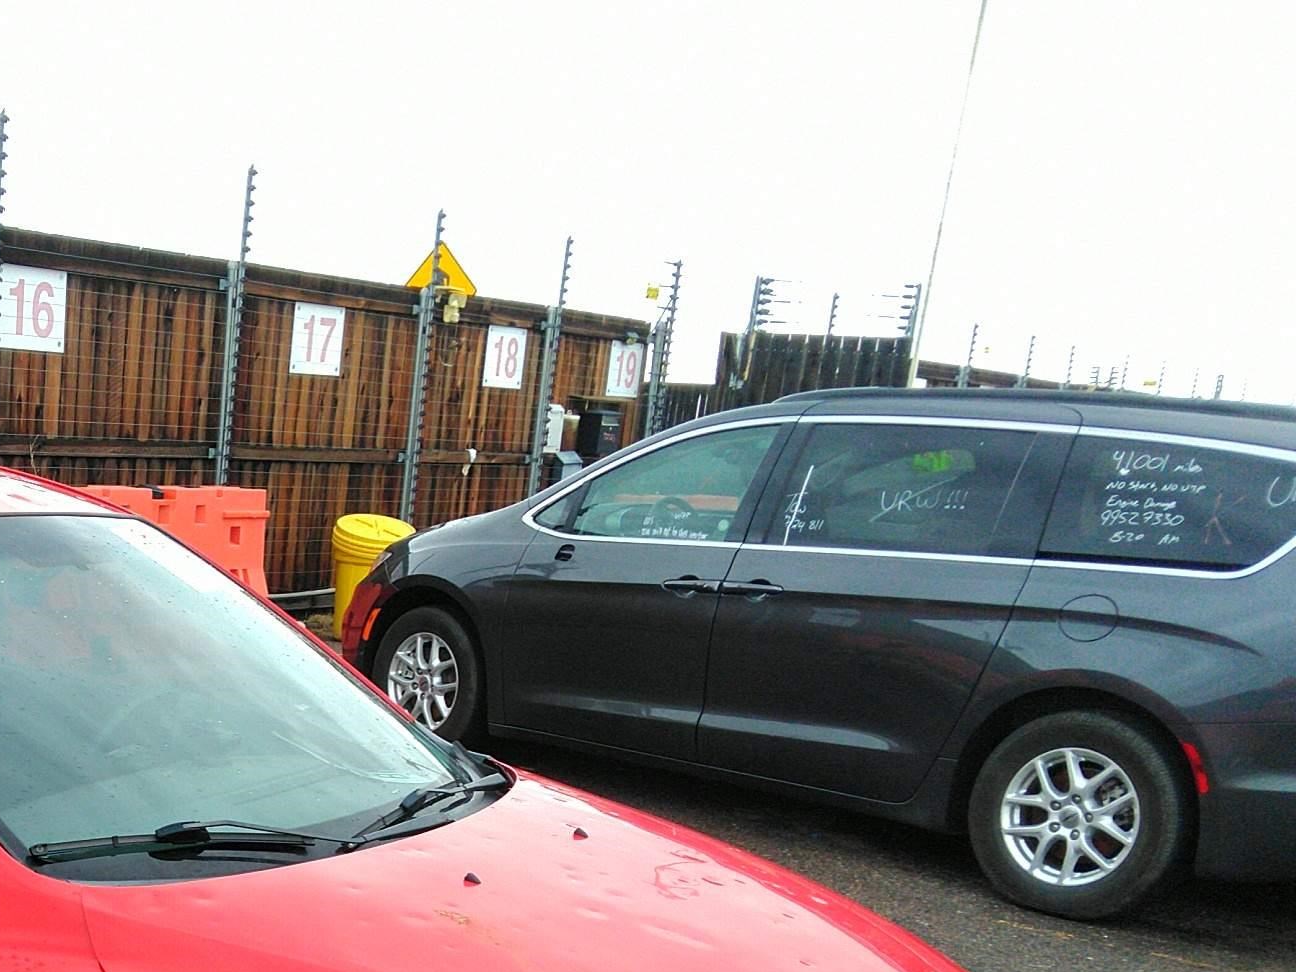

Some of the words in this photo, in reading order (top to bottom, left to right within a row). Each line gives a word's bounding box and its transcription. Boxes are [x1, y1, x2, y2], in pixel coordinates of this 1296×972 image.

[8, 276, 57, 340] 16
[302, 313, 338, 365] 17
[493, 334, 519, 380] 18
[614, 348, 638, 389] 19
